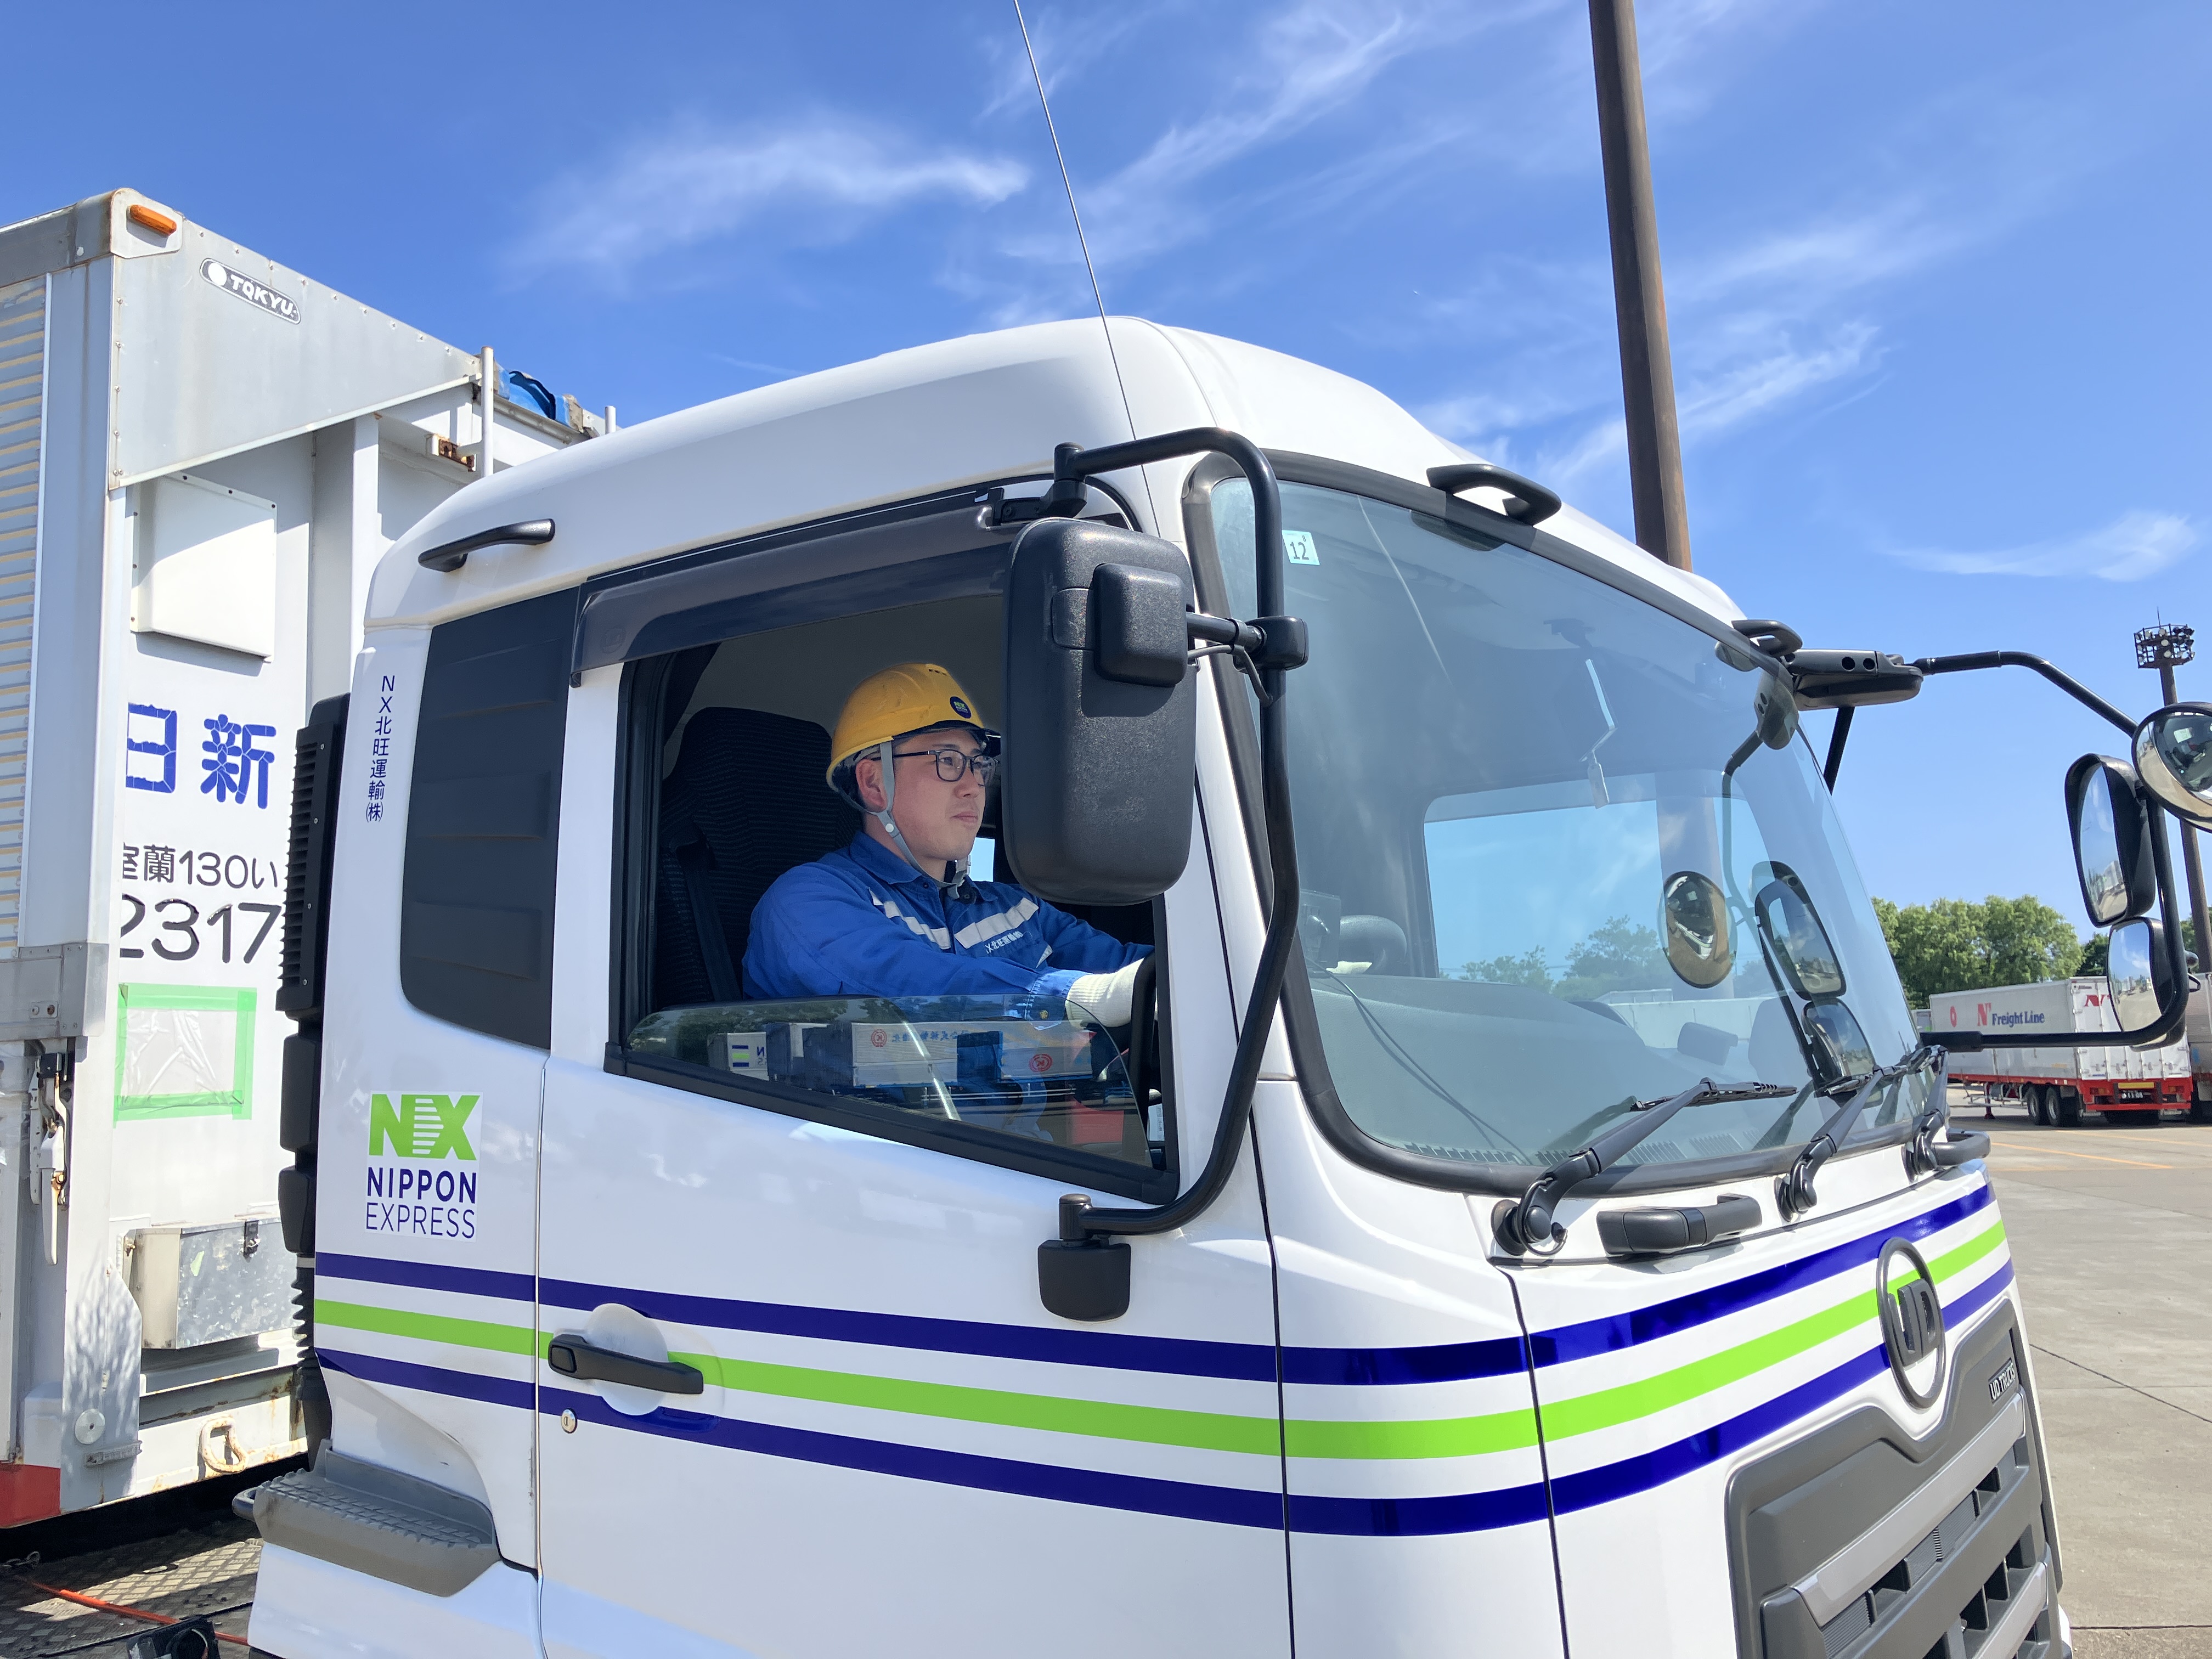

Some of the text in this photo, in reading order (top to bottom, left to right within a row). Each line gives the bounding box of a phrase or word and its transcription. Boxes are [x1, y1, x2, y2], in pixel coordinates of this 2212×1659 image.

[1289, 541, 1310, 561] 12
[120, 893, 282, 964] 2317
[1992, 1011, 2024, 1028] Freight
[2024, 1011, 2045, 1024] Line
[369, 1093, 481, 1161] NX
[367, 1166, 477, 1204] NIPPON
[366, 1201, 475, 1239] EXPRESS
[1990, 1379, 2001, 1400] UD
